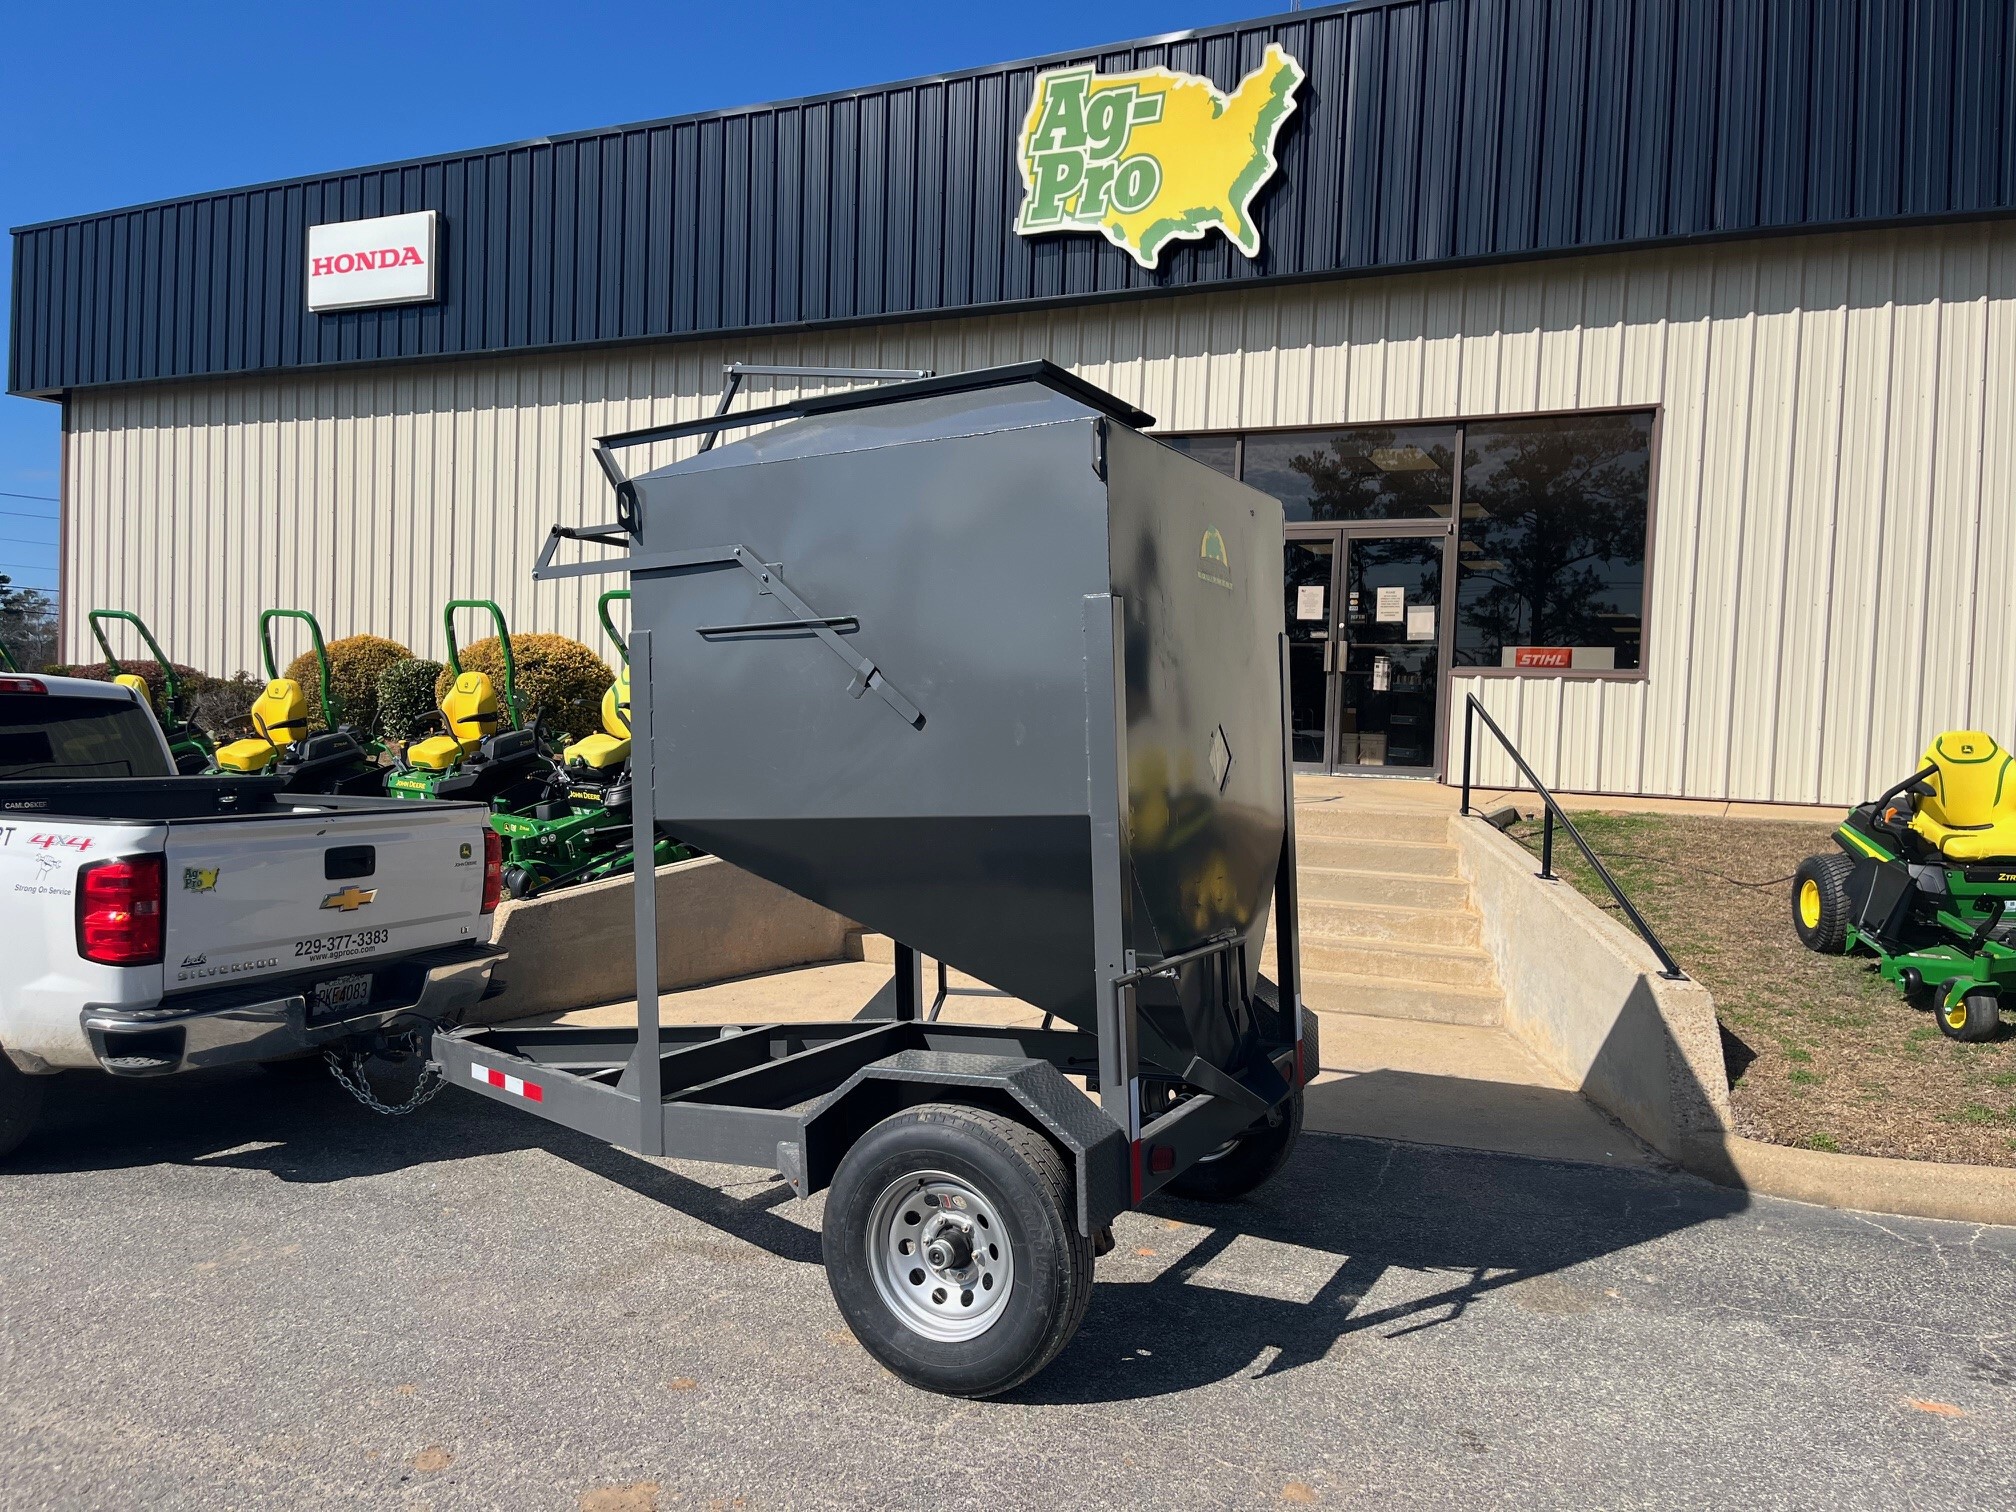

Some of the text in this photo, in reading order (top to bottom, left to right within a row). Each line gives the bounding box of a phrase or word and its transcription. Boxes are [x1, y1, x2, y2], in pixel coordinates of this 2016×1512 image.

[1027, 71, 1164, 160] Ag-
[1023, 146, 1163, 227] Pro
[312, 246, 424, 276] HONDA
[1520, 654, 1565, 666] STIHL
[569, 790, 601, 800] JOHN DEERE
[15, 884, 36, 894] Strong
[49, 887, 72, 896] Service
[295, 929, 389, 957] 229-377-3383
[310, 945, 376, 962] www.agproco.com
[178, 958, 279, 981] SILVERADO
